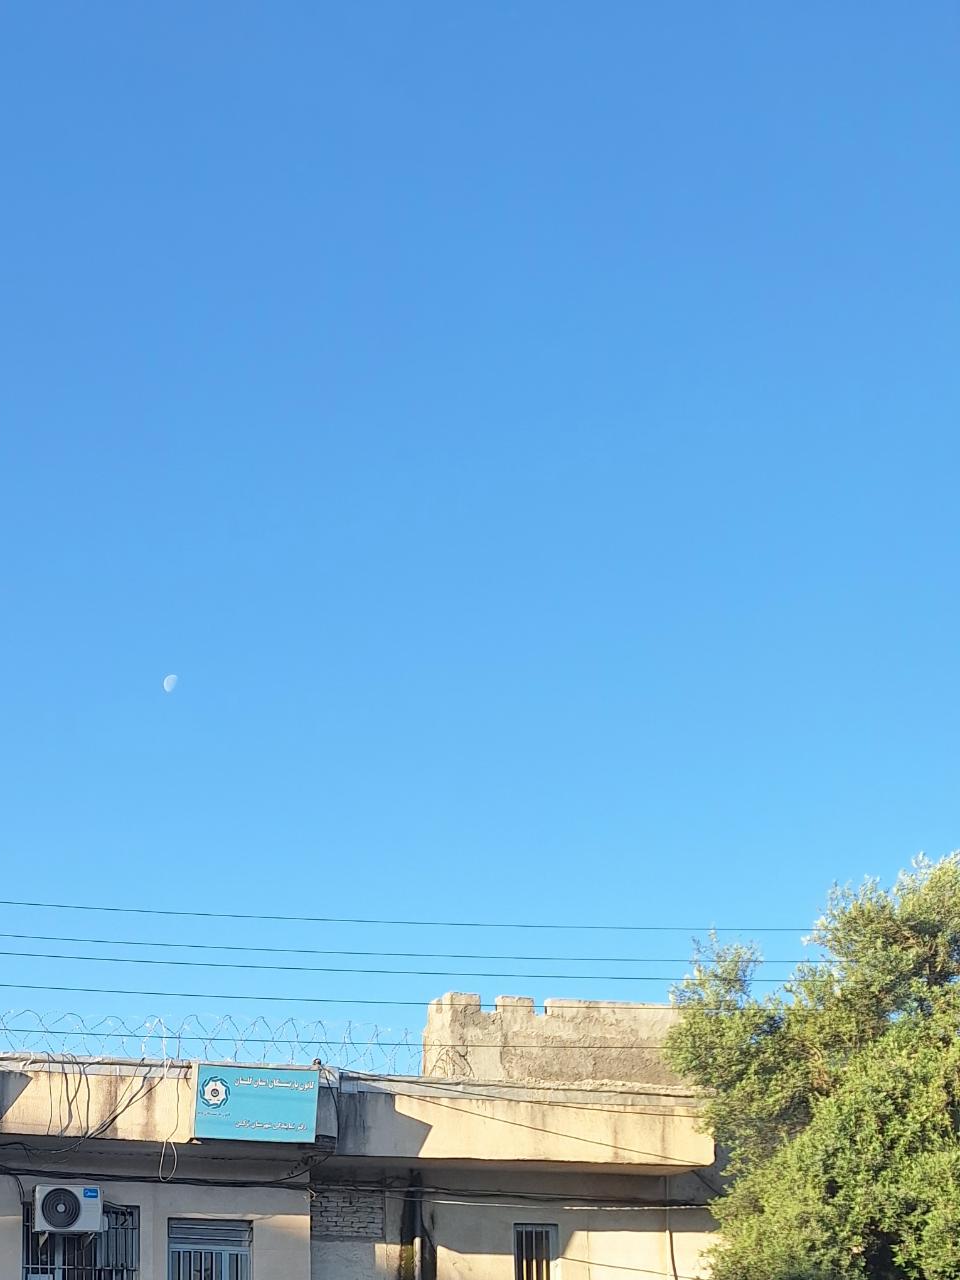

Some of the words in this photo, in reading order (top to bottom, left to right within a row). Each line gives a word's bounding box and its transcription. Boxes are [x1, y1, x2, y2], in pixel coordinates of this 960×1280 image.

[235, 1076, 252, 1087] گلستان
[253, 1077, 269, 1087] استان
[268, 1077, 299, 1091] بازنشستگان
[299, 1080, 314, 1091] کانون
[272, 1121, 295, 1130] نمایندگی
